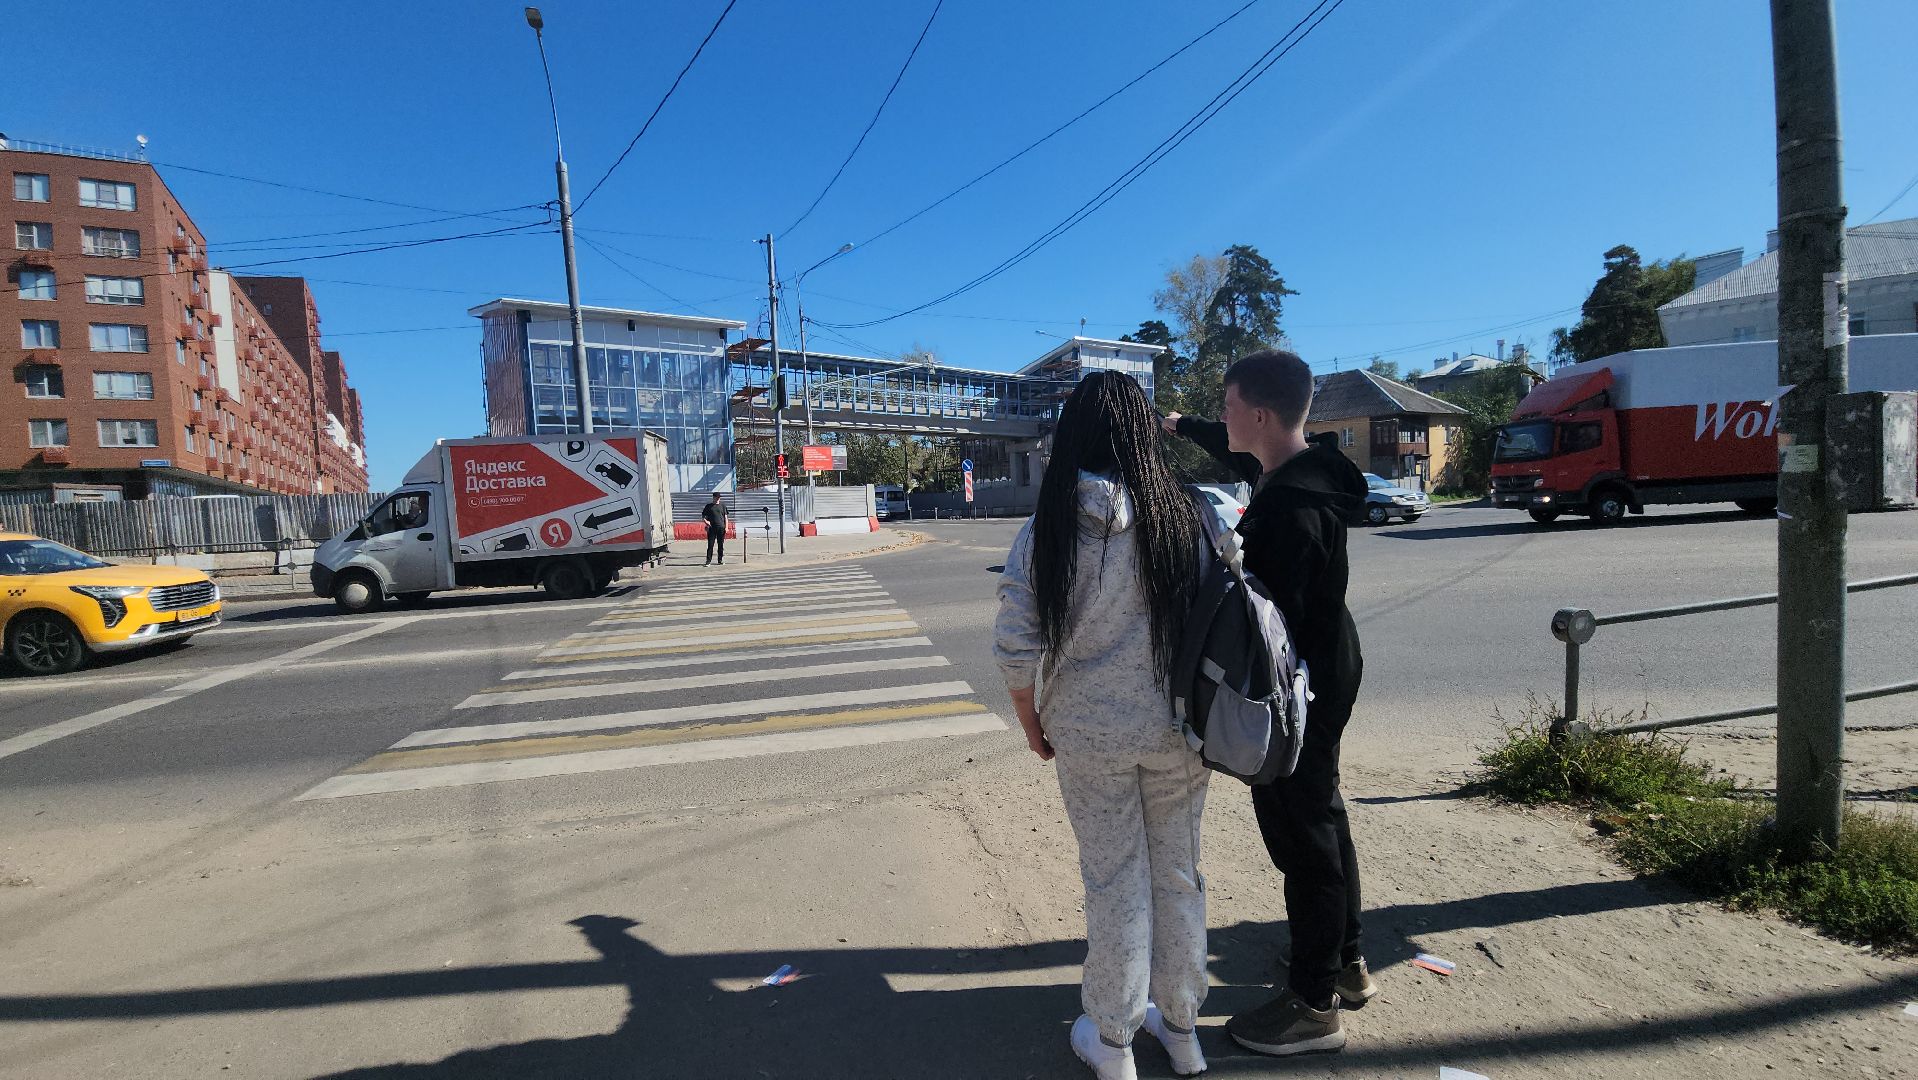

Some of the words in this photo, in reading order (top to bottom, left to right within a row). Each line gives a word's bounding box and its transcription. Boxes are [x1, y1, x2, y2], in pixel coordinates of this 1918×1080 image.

[464, 459, 526, 476] Яндекс
[465, 475, 547, 494] Доставка
[548, 523, 565, 543] Я
